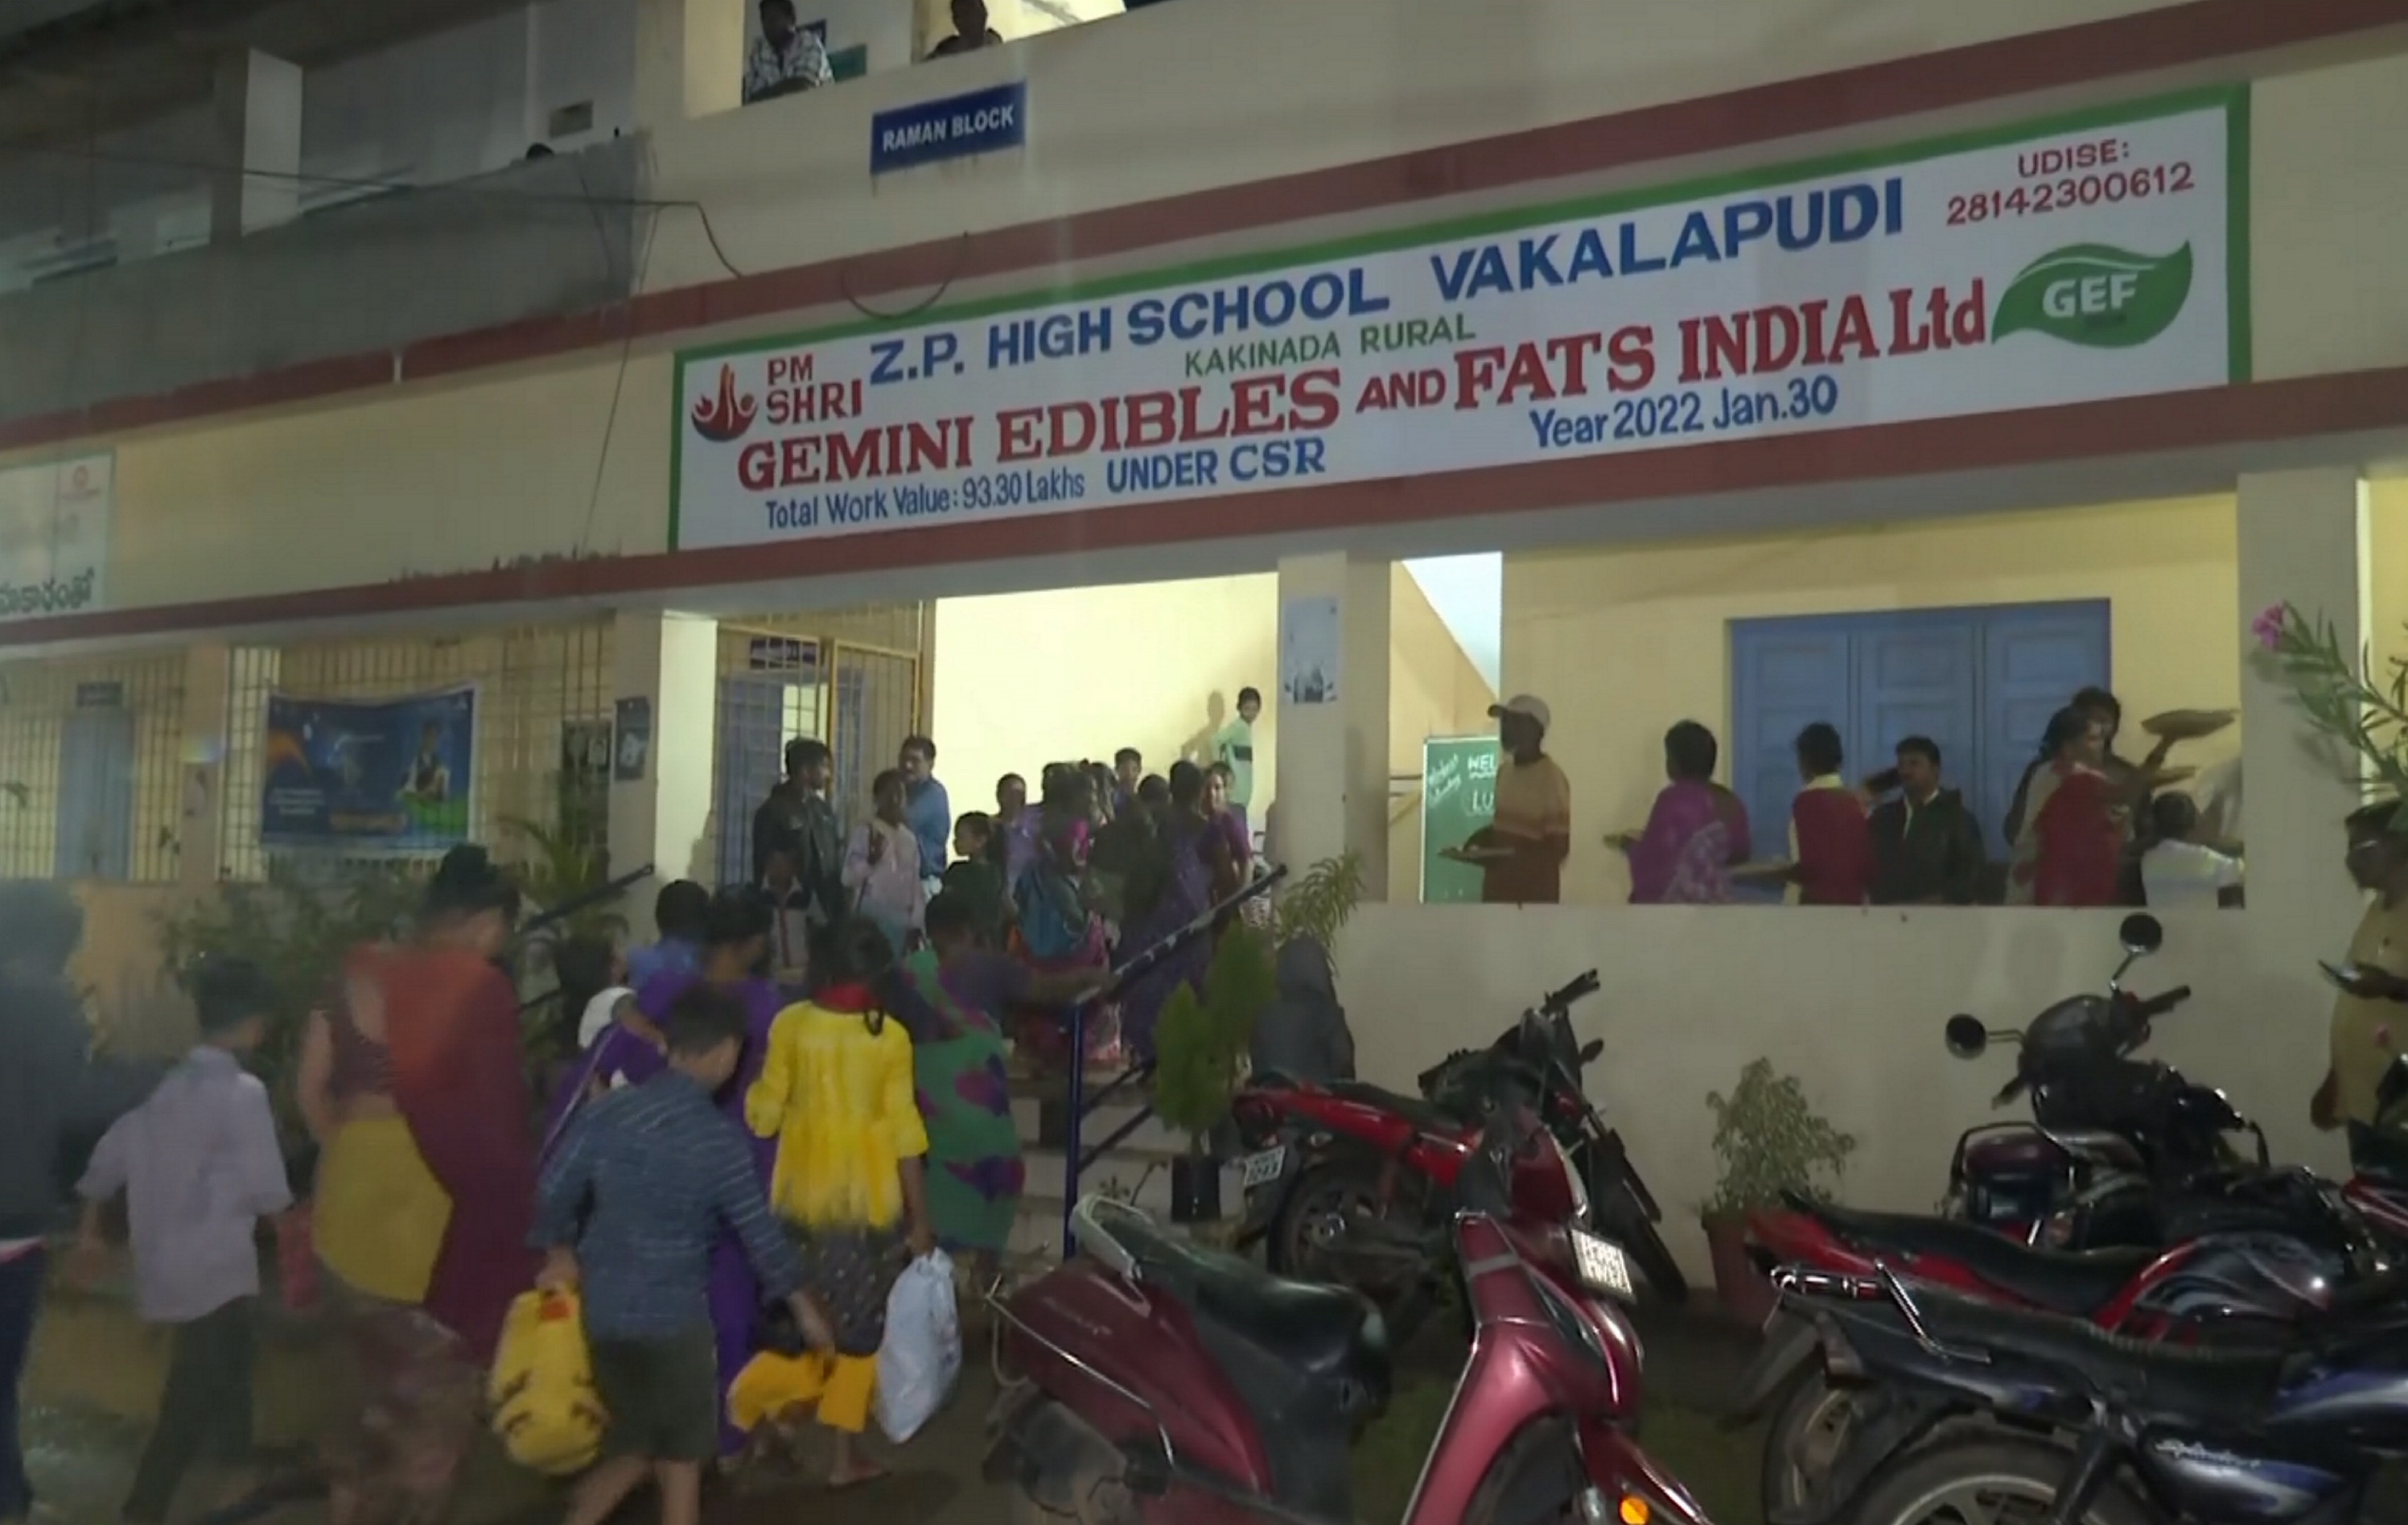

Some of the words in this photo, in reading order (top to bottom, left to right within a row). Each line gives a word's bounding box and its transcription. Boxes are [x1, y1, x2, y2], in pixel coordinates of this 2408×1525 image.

[883, 118, 947, 152] RAMAN
[952, 103, 1014, 137] BLOCK
[2018, 140, 2129, 178] UDISE:
[1947, 162, 2194, 226] 28142300612
[870, 332, 964, 385] Z.P.
[988, 308, 1111, 369] HIGH
[1127, 268, 1390, 346] SCHOOL
[1430, 177, 1902, 302] VAKALAPUDI
[2043, 274, 2139, 317] GEF
[768, 354, 813, 385] PM
[1185, 332, 1340, 377] KAKINADA
[1361, 313, 1475, 354] RURAL
[738, 417, 974, 491] GEMINI
[997, 368, 1341, 463] EDIBLES
[1356, 369, 1446, 413] AND
[1454, 326, 1654, 410] FATS
[1678, 294, 1880, 384] INDIA
[1888, 277, 1986, 356] Ltd
[767, 379, 862, 425] SHRI
[1530, 408, 1607, 448] Year
[1613, 391, 1704, 439] 2022
[1713, 374, 1838, 429] Jan.30
[766, 497, 818, 529] Total
[826, 488, 888, 524] Work
[963, 473, 1022, 508] 93.30
[1027, 467, 1085, 503] Lakhs
[1107, 450, 1218, 493] UNDER
[1230, 437, 1325, 481] CSR
